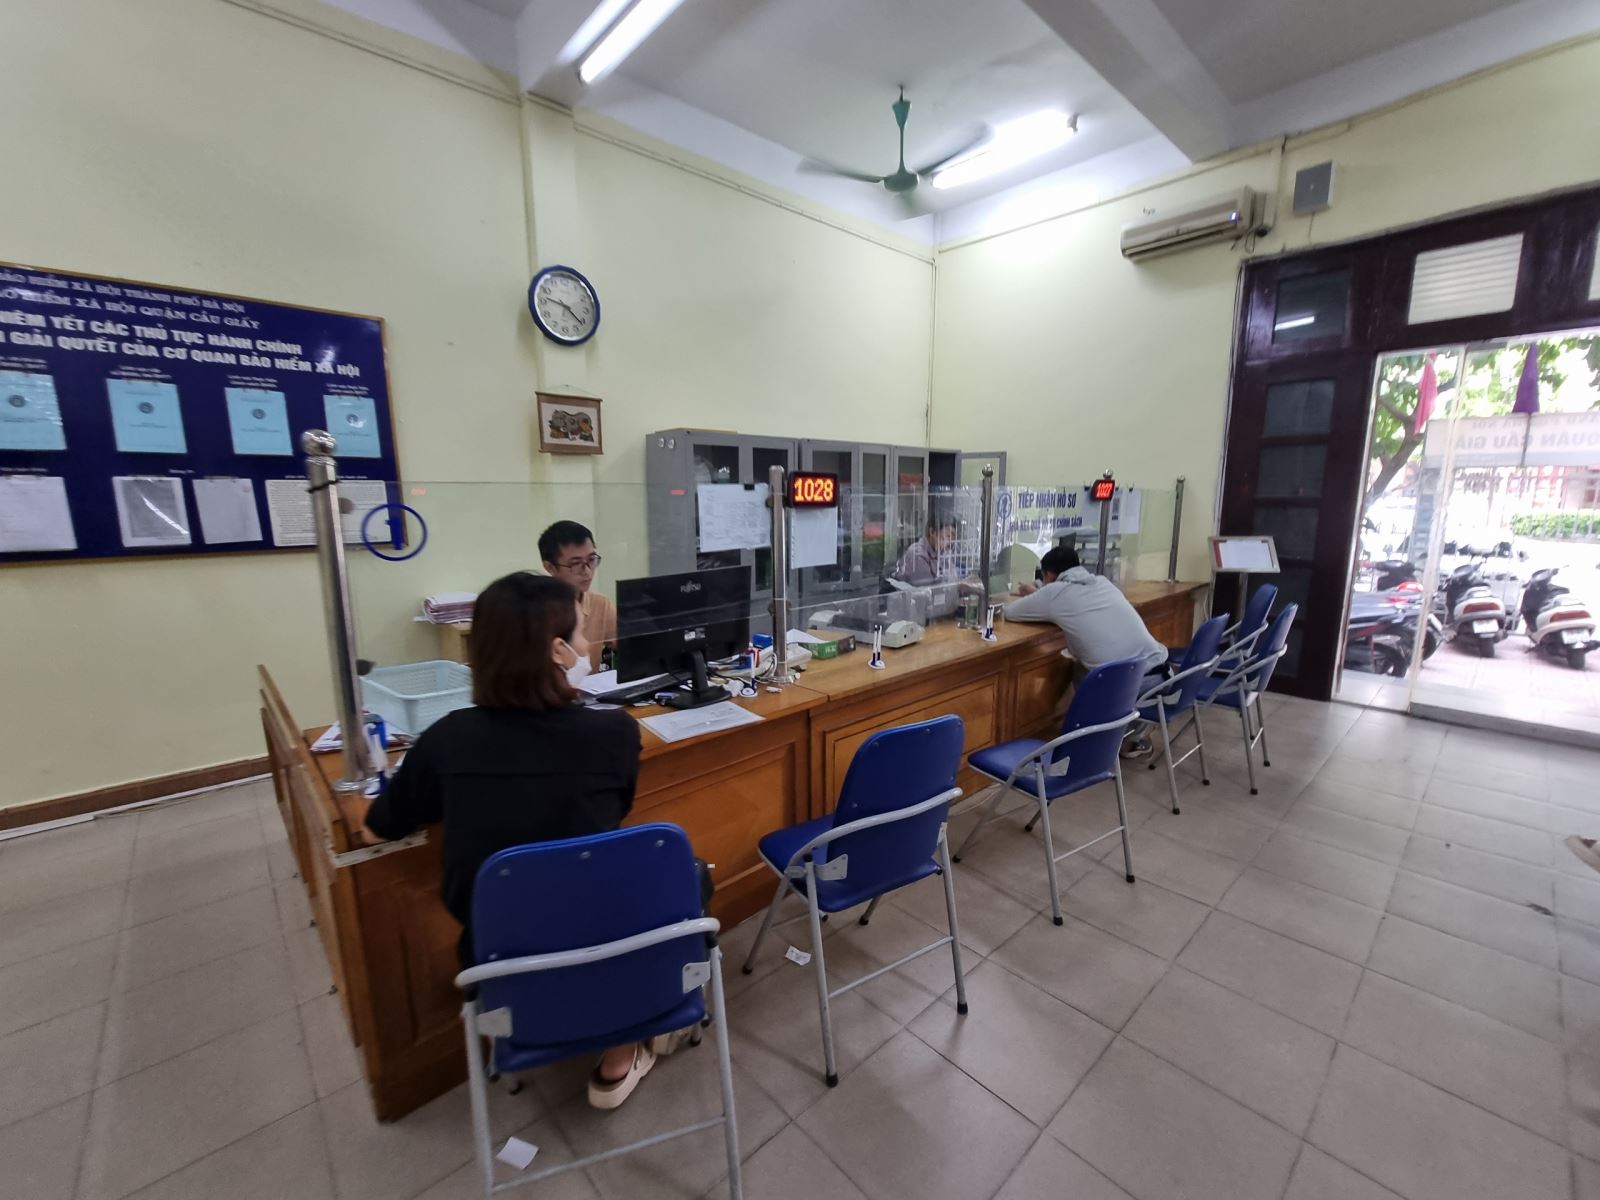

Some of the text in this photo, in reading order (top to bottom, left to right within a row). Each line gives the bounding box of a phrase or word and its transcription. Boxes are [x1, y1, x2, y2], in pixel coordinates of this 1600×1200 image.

[50, 313, 87, 331] YẾT
[90, 319, 130, 336] CÁC
[132, 322, 168, 341] THỦ
[171, 329, 205, 346] TỤC
[207, 332, 253, 350] HÀNH
[256, 339, 303, 356] CHÍNH
[10, 328, 54, 348] GIẢI
[58, 333, 117, 354] QUYẾT
[122, 338, 160, 358] CỦA
[163, 345, 188, 361] CƠ
[190, 348, 237, 366] QUAN
[240, 350, 272, 368] BẢO
[274, 355, 312, 372] HIỂM
[314, 361, 335, 375] XÃ
[337, 364, 361, 379] HỘI
[794, 478, 834, 502] 1028
[1018, 486, 1077, 512] TIẾP NHẬN HỒ SƠ
[1096, 482, 1114, 498] 1027
